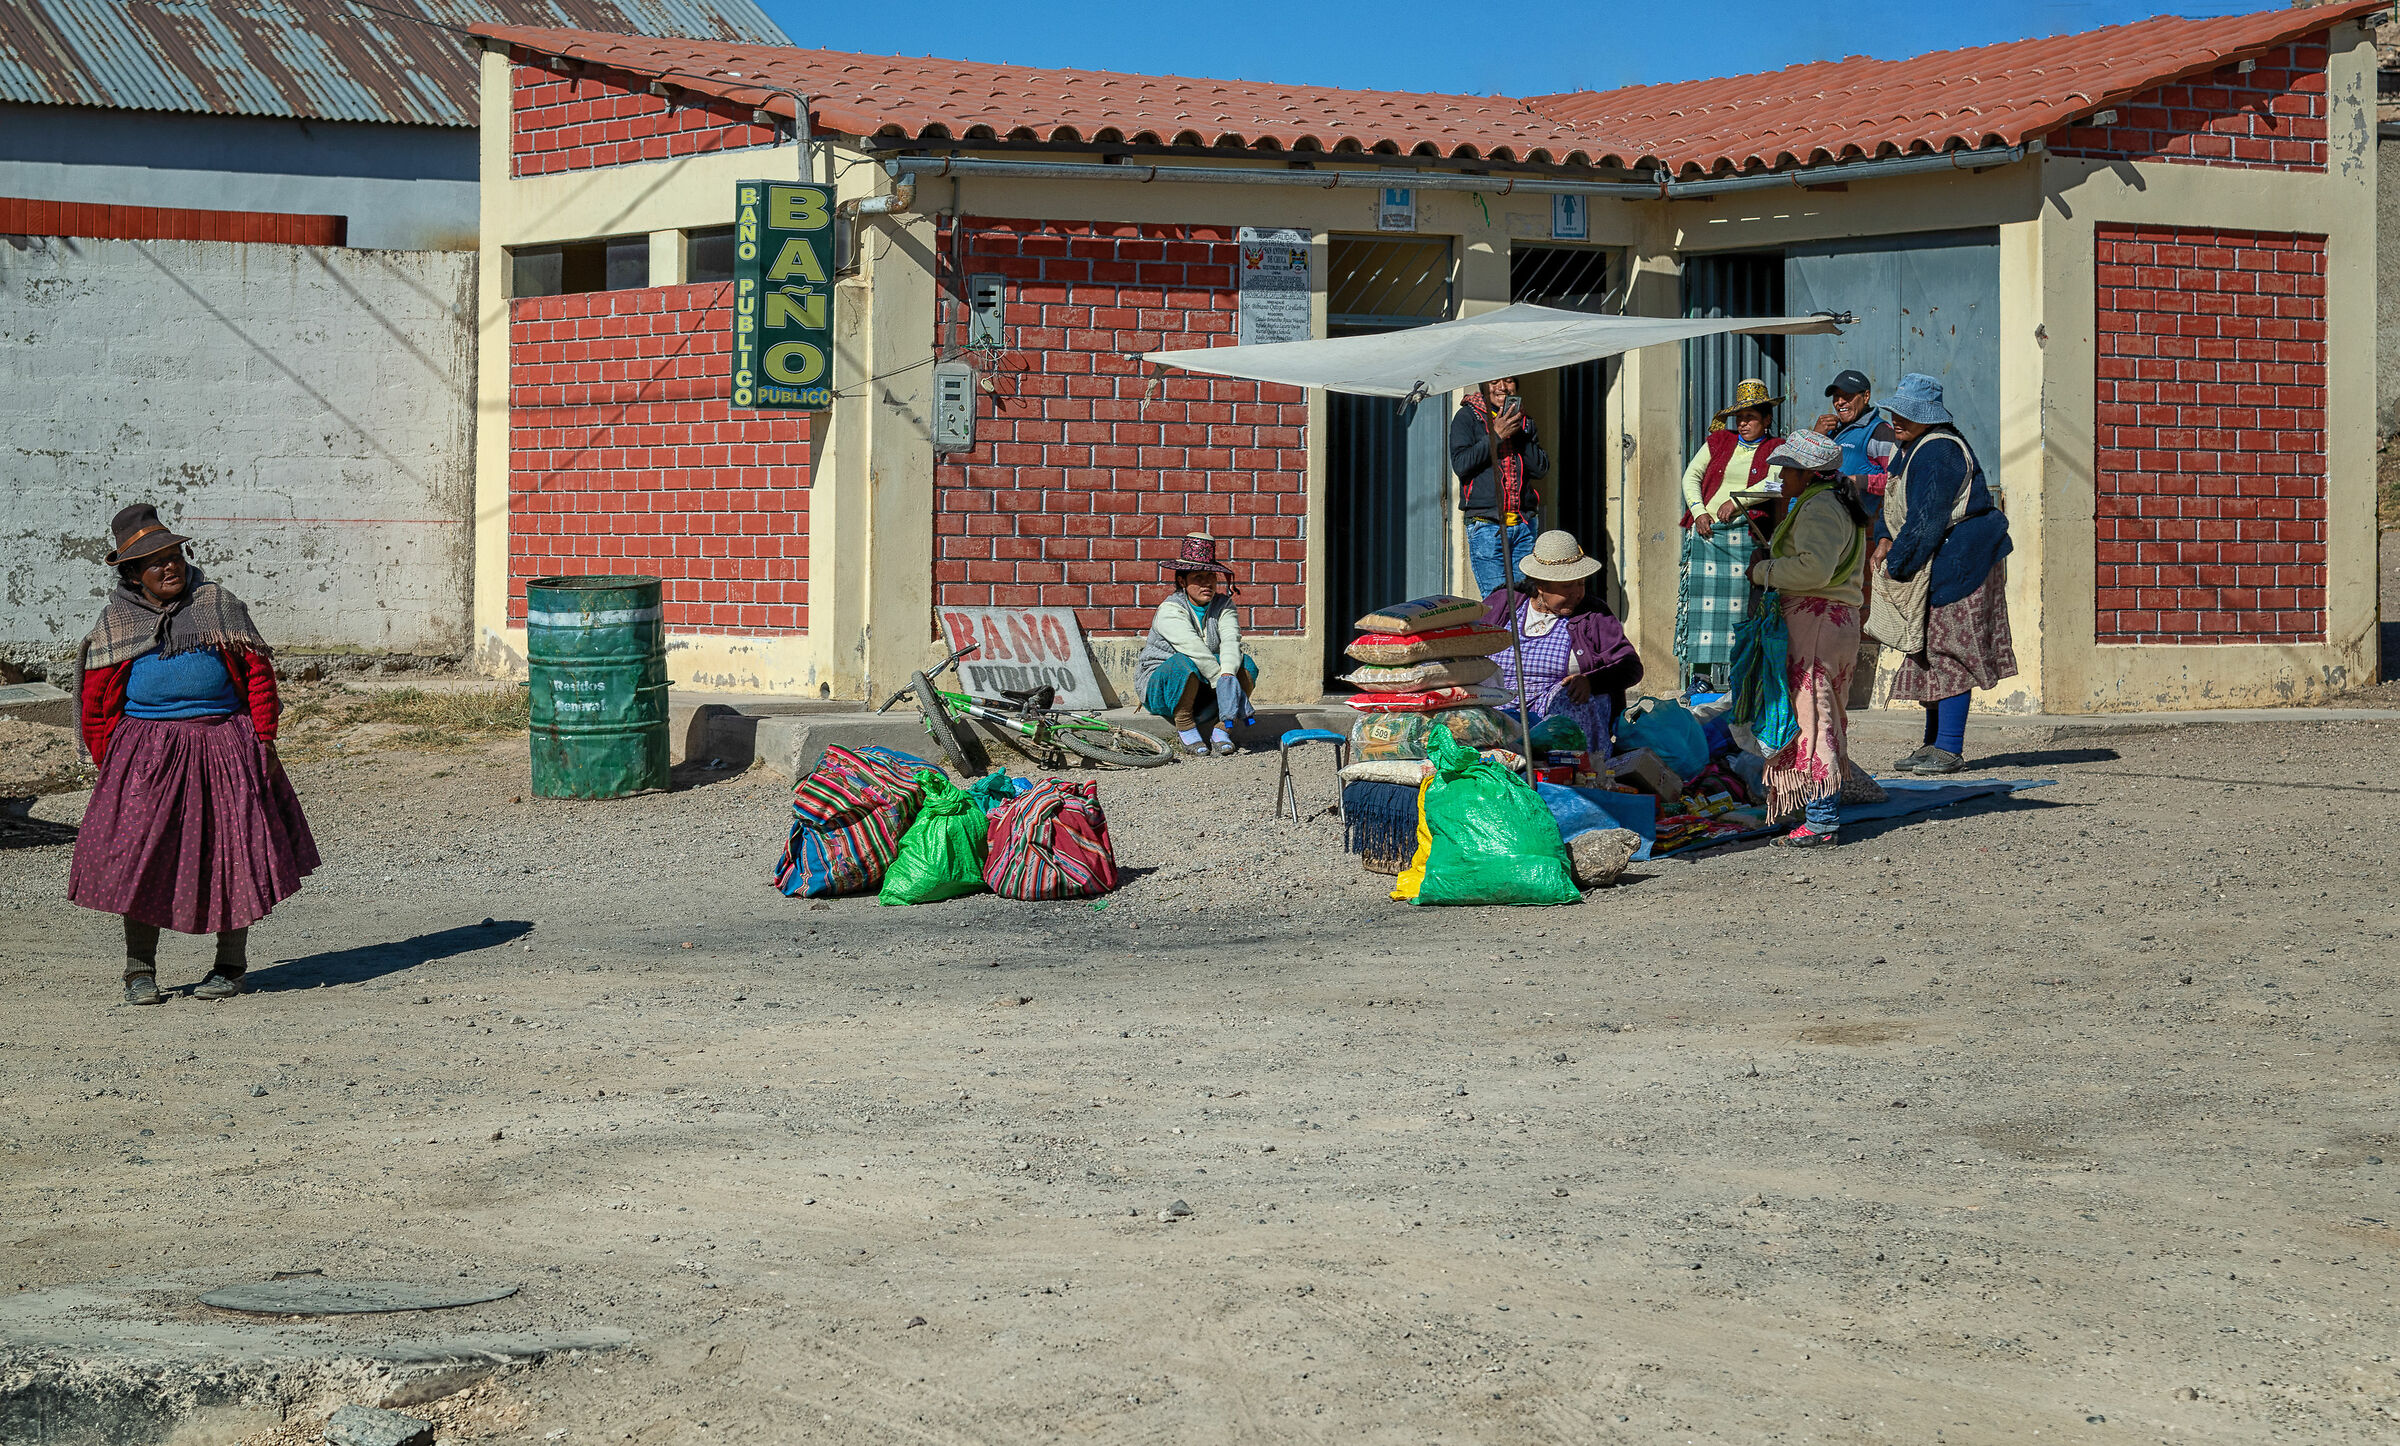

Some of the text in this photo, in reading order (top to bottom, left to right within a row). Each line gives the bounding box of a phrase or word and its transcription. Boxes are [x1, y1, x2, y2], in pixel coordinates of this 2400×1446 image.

[764, 185, 830, 385] BAÑO
[734, 279, 755, 406] PUBLICO
[757, 386, 831, 405] PUBLICO
[967, 664, 1076, 692] PUBLICO
[1374, 728, 1389, 739] 509
